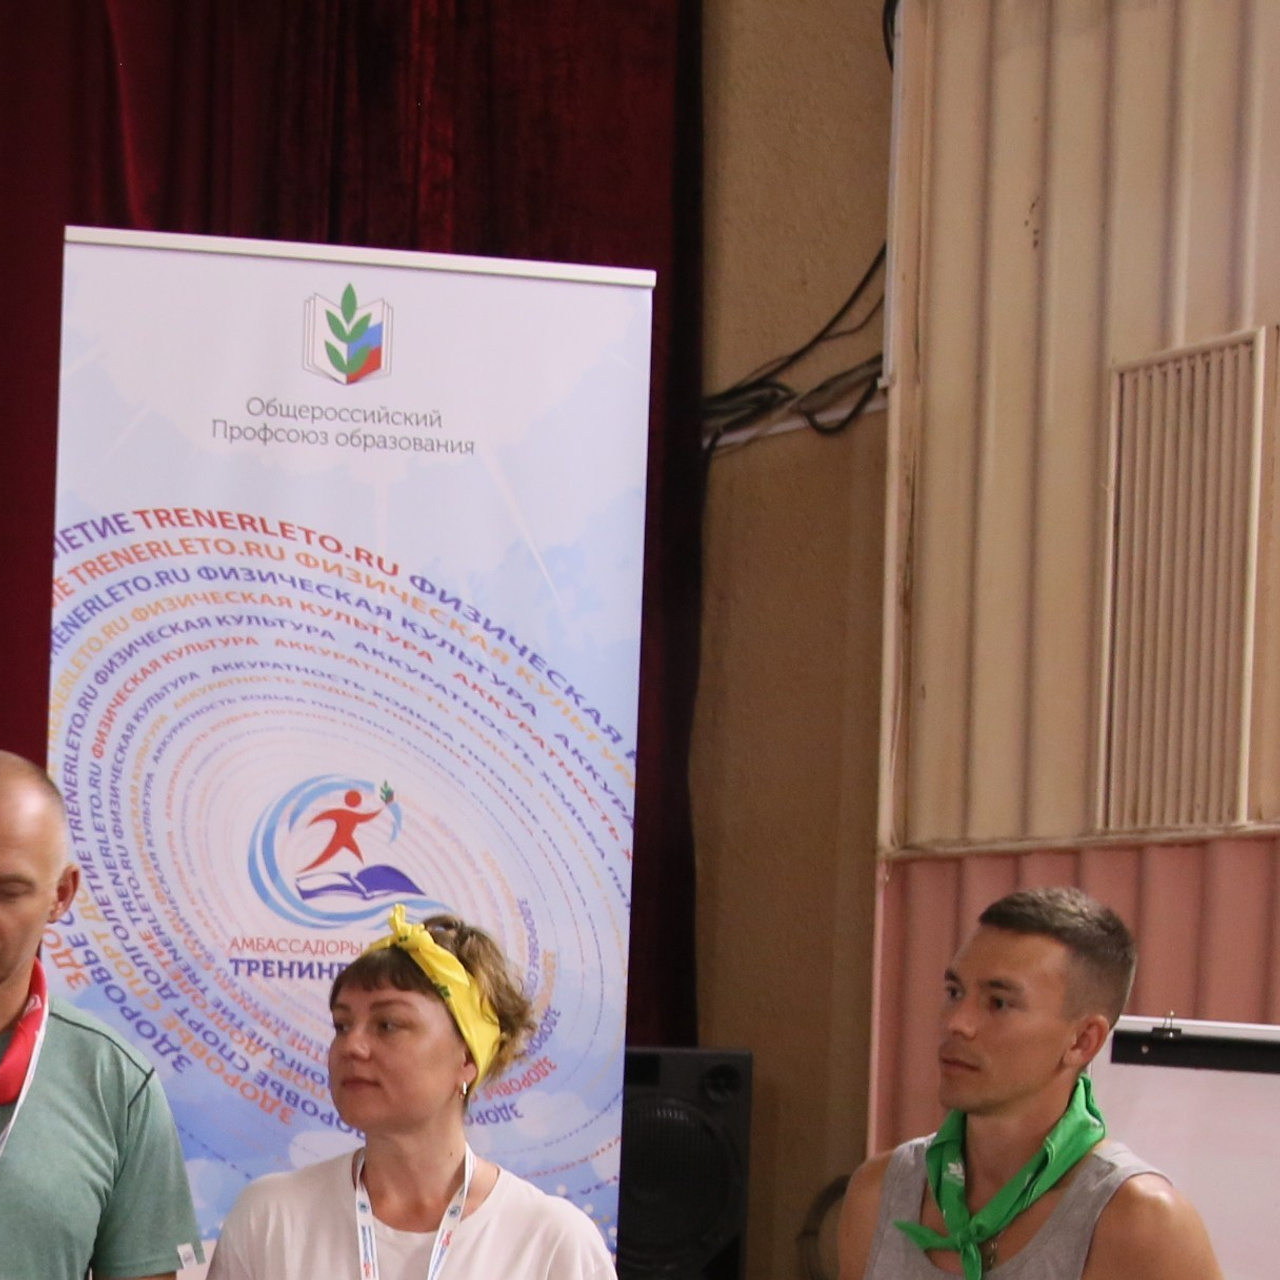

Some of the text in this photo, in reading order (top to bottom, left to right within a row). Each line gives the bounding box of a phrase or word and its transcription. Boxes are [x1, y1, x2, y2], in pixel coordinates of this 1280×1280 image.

[211, 419, 475, 456] Профсоюз образования
[245, 396, 442, 429] Общероссийский
[67, 537, 286, 586] TRENERLETO.RU
[294, 551, 510, 666] ФИЗИЧЕСКАЯ
[94, 614, 213, 685] ФИЗИЧЕСКАЯ
[132, 507, 399, 577] TRENERLETO.RU
[409, 574, 623, 744] ФИЗИЧЕСКАЯ
[160, 635, 260, 665] КУЛЬТУРА
[197, 565, 393, 622] ФИЗИЧЕСКАЯ
[401, 616, 536, 718] КУЛЬТУРА
[216, 614, 337, 642] КУЛЬТУРА
[91, 658, 162, 759] ФИЗИЧЕСКАЯ
[130, 590, 294, 622] ФИЗИЧЕСКАЯ
[299, 599, 434, 664] КУЛЬТУРА
[452, 672, 620, 841] АККУРАТНОСТЬ
[132, 671, 201, 723] КУЛЬТУРА
[353, 640, 536, 768] АККУРАТНОСТЬ
[63, 683, 99, 845] TRENERLETO.RU
[109, 720, 137, 840] ФИЗИЧЕСКАЯ
[88, 761, 143, 926] TRENERLETO.RU
[76, 849, 180, 1000] ДОЛГОЛЕТИЕ
[91, 930, 162, 1011] СПОРТ
[116, 843, 209, 995] TRENERLETO.RU
[229, 936, 363, 957] АМБАССАДОРЫ
[66, 931, 193, 1074] ЗДОРОВЬЕ
[173, 1005, 250, 1073] СПОРТ
[210, 996, 328, 1086] ОЛГОЛЕТИЕ
